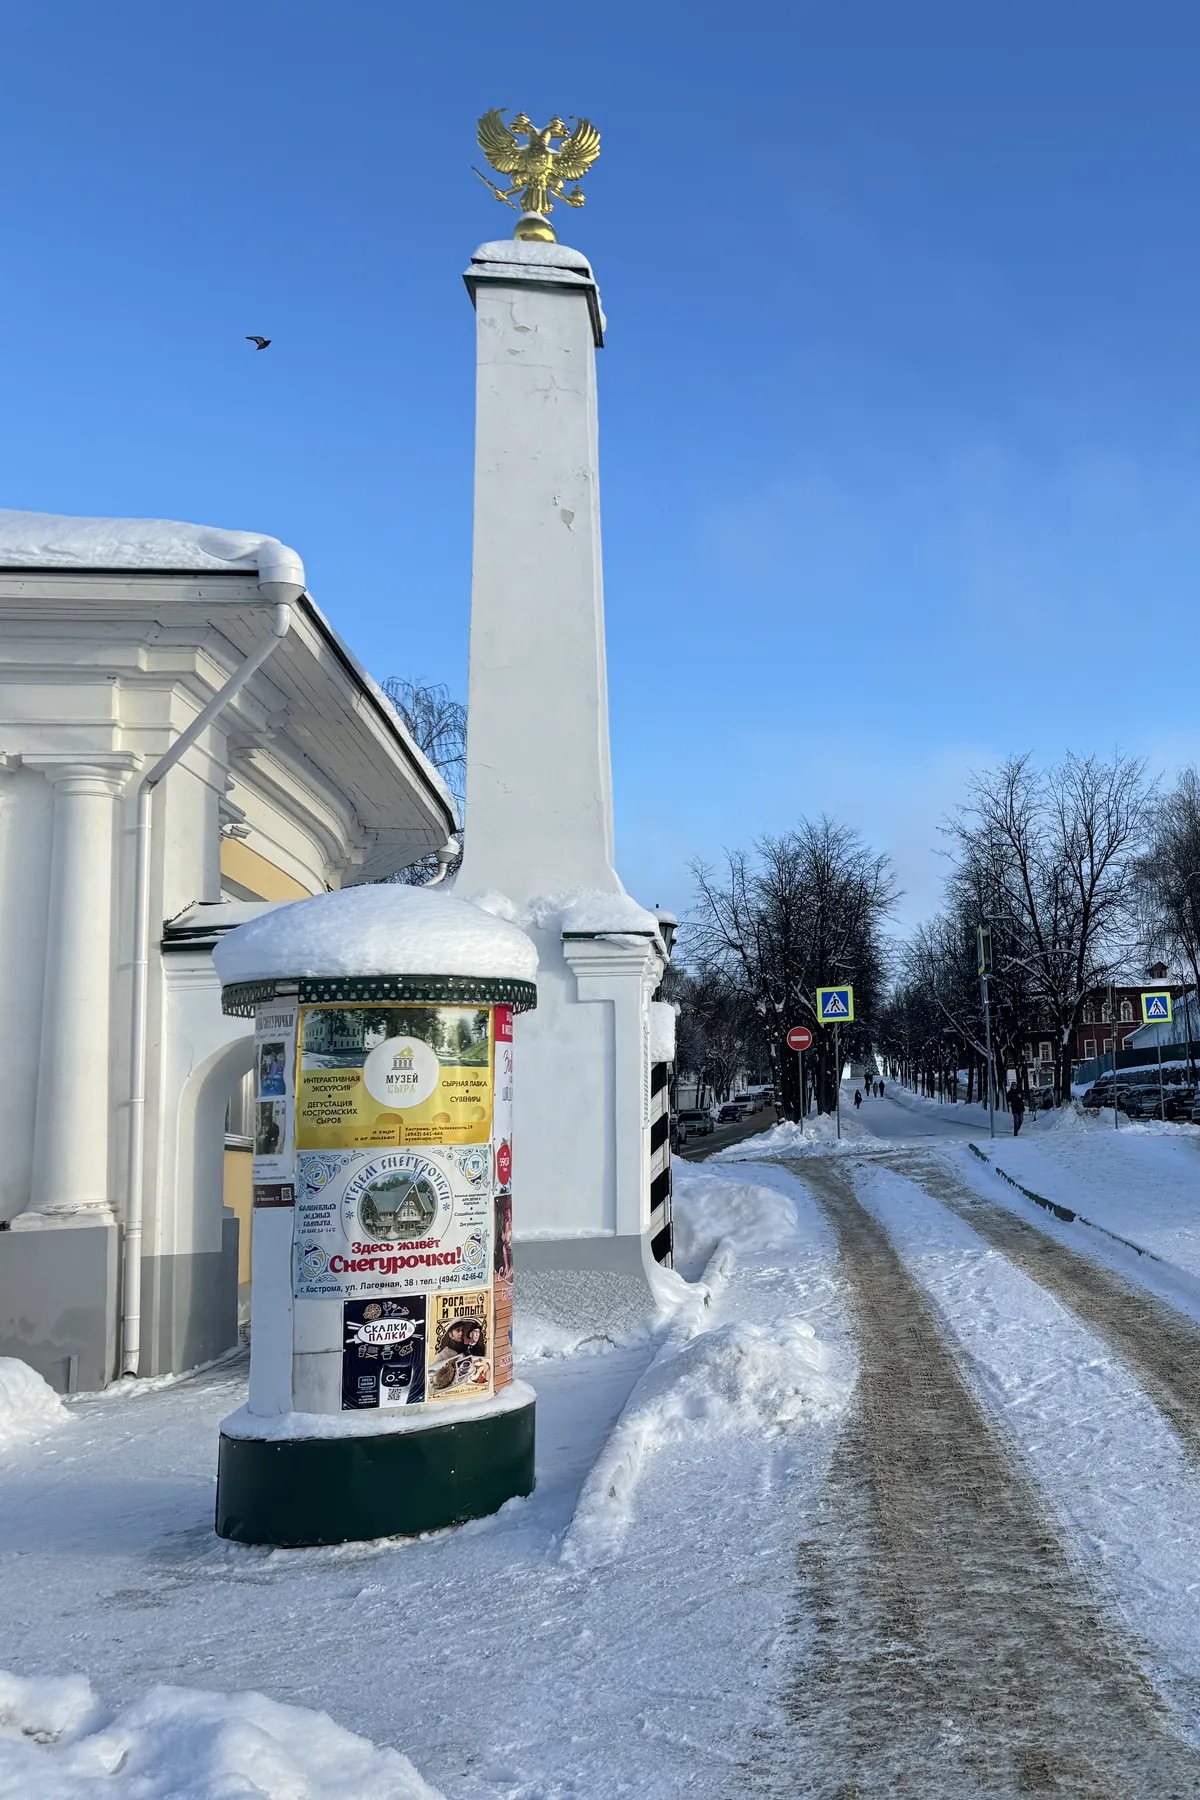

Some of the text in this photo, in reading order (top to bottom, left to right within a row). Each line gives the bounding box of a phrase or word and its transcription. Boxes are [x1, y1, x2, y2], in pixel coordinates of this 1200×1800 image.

[303, 1075, 360, 1084] ИНТЕРАКТИВНАЯ
[386, 1073, 418, 1083] МУЗЕЙ
[311, 1084, 351, 1092] ЭКСКУРСИЯ
[387, 1084, 416, 1094] СЫРА
[307, 1100, 352, 1109] ДЕГУСТАЦИЯ
[302, 1109, 357, 1117] КОСТРОМСКИХ
[316, 1117, 341, 1125] СЫРОВ
[345, 1156, 450, 1203] ТЕРЕМ СНЕГУРОЧКИ
[351, 1237, 441, 1255] Здесь живёт
[329, 1246, 462, 1275] Снегурочка!
[306, 1285, 343, 1294] Кострома,
[345, 1284, 358, 1293] ул.
[360, 1281, 402, 1290] Лагерная,
[404, 1278, 414, 1287] 38
[420, 1277, 437, 1285] тел.:
[439, 1273, 460, 1284] (4942)
[461, 1271, 484, 1281] 42-66-42
[442, 1295, 464, 1307] РОГА
[442, 1305, 484, 1318] И КОПЫТА
[363, 1322, 408, 1334] СКАЛКИ
[368, 1331, 406, 1342] ПАЛКИ
